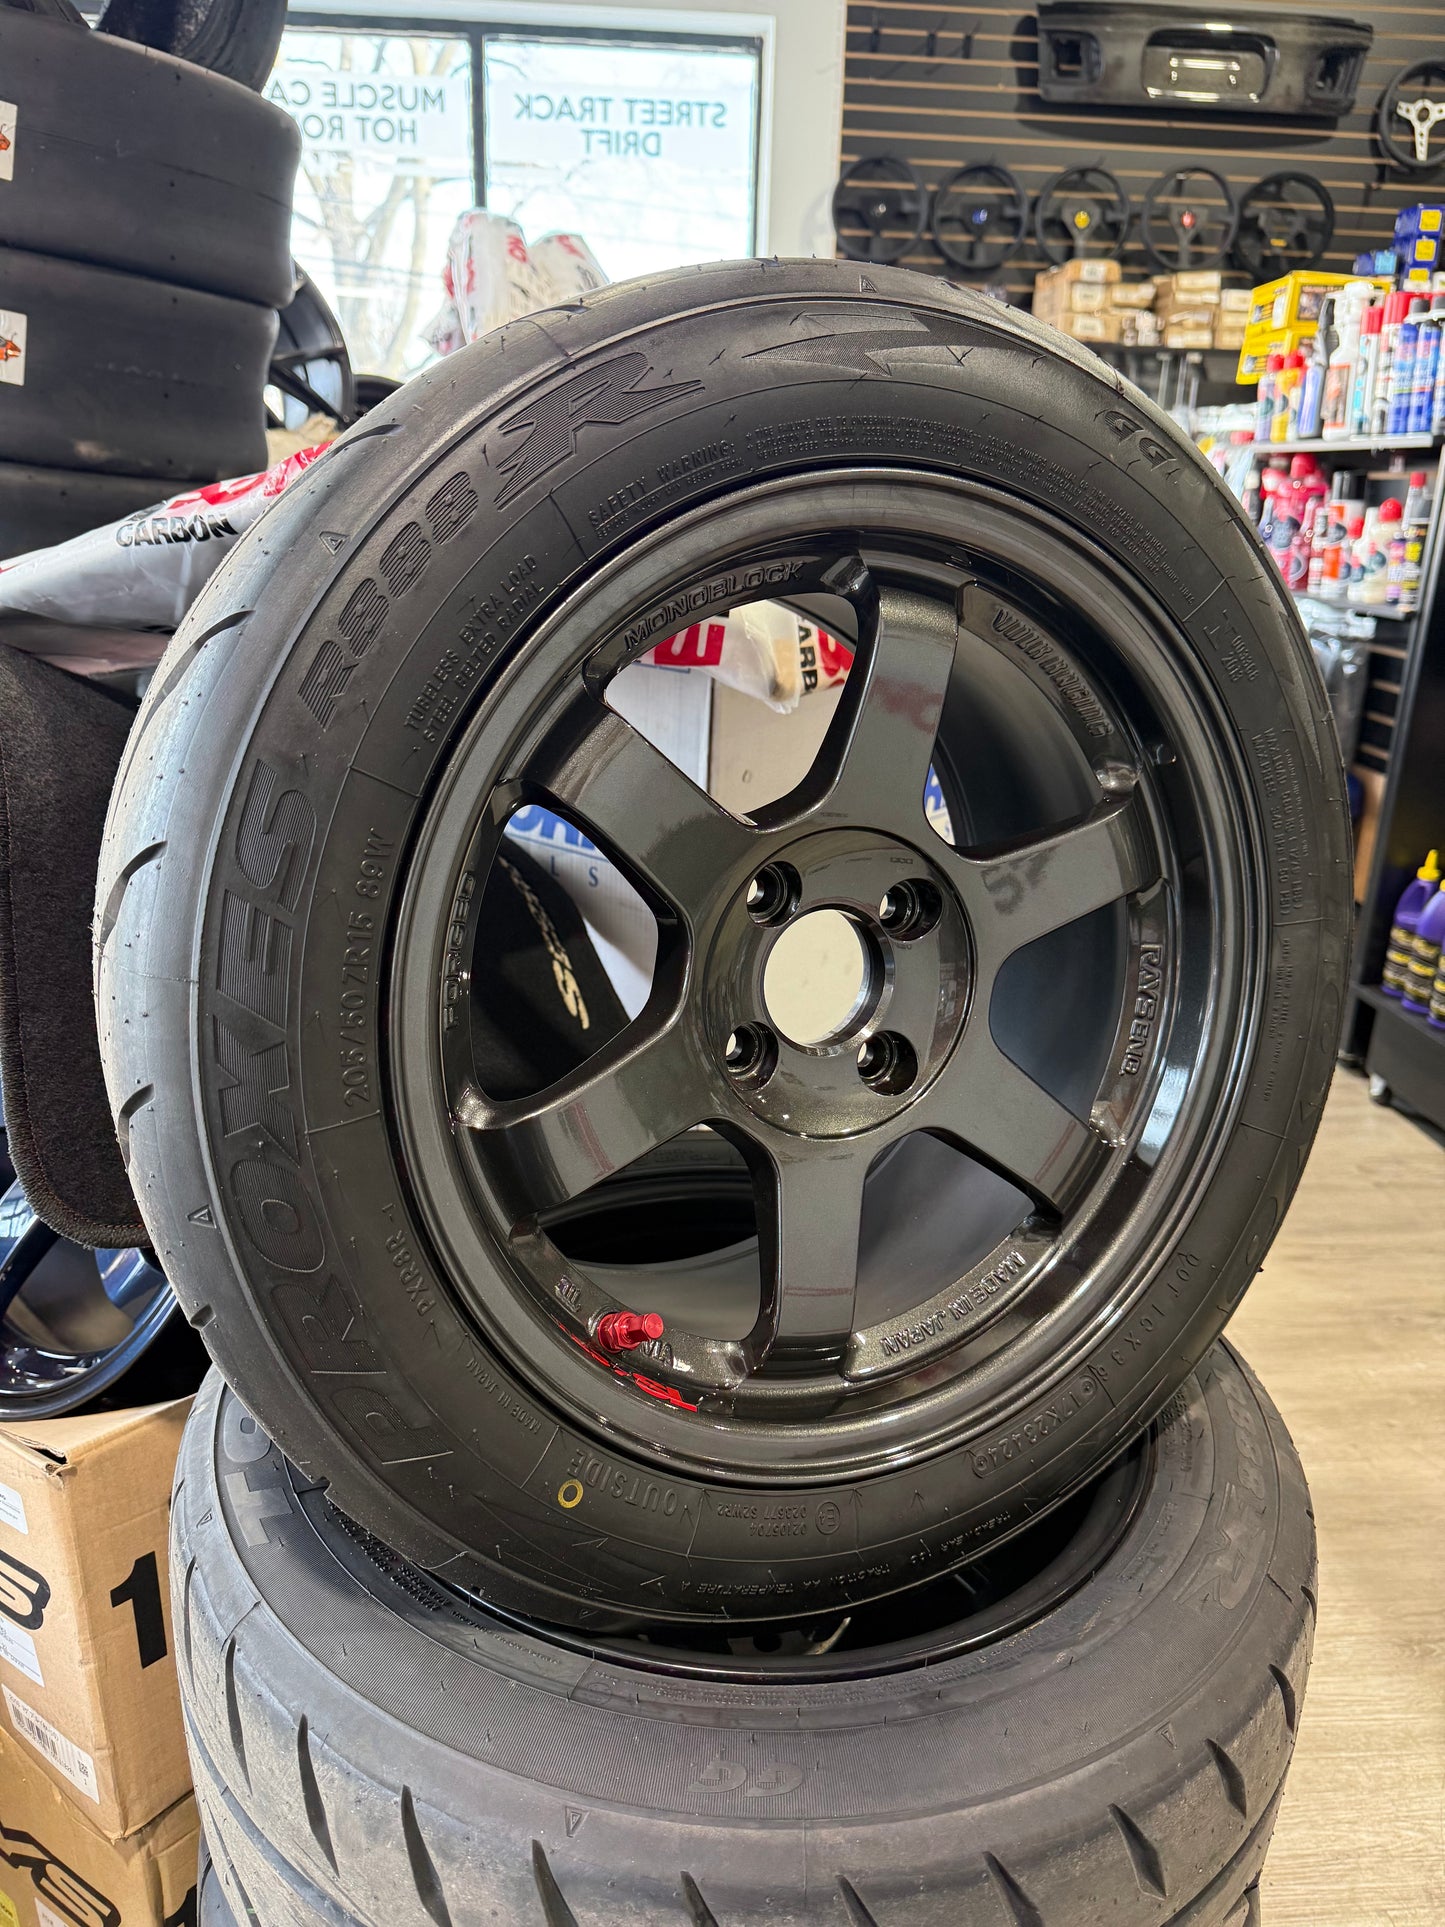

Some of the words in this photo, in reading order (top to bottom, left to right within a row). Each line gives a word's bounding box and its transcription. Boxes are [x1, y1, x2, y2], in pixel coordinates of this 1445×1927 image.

[116, 514, 238, 547] CARBON
[584, 472, 651, 529] SAFETY
[404, 649, 459, 730] TUBELESS
[459, 593, 504, 646] EXTRA
[501, 554, 536, 594] LOAD
[624, 562, 807, 650] MONOBLOCK
[350, 823, 398, 901] 89W
[212, 757, 455, 1465] PROXES
[948, 1294, 976, 1320] IN
[969, 1250, 1027, 1304] MADE
[880, 1310, 946, 1356] JAPAN
[563, 1445, 680, 1519] OUTSIDE
[110, 1550, 168, 1669] 1
